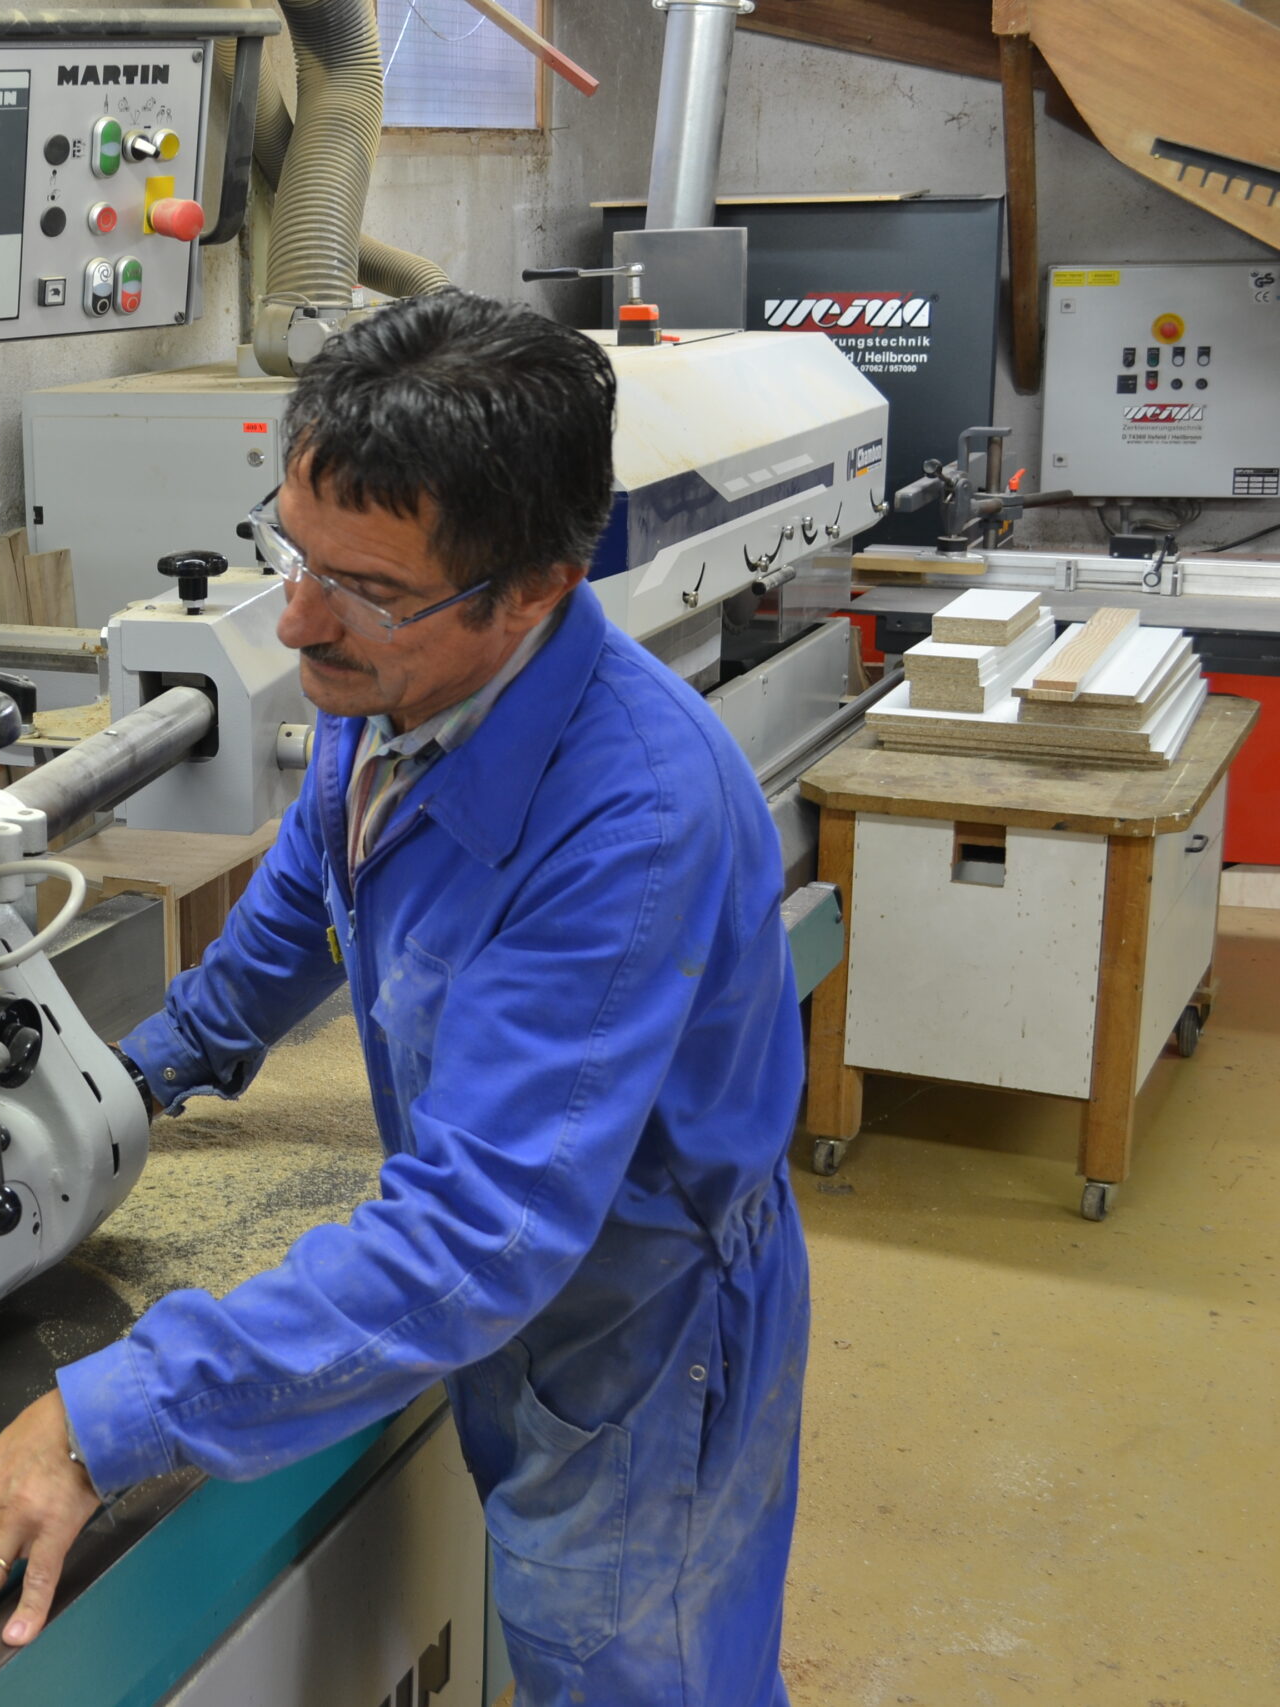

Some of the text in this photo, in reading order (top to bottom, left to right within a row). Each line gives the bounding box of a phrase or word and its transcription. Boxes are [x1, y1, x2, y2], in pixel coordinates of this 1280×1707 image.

[57, 64, 170, 86] MARTIN
[864, 351, 928, 363] Heilbronn
[860, 364, 883, 373] 07062
[889, 364, 917, 373] 957090
